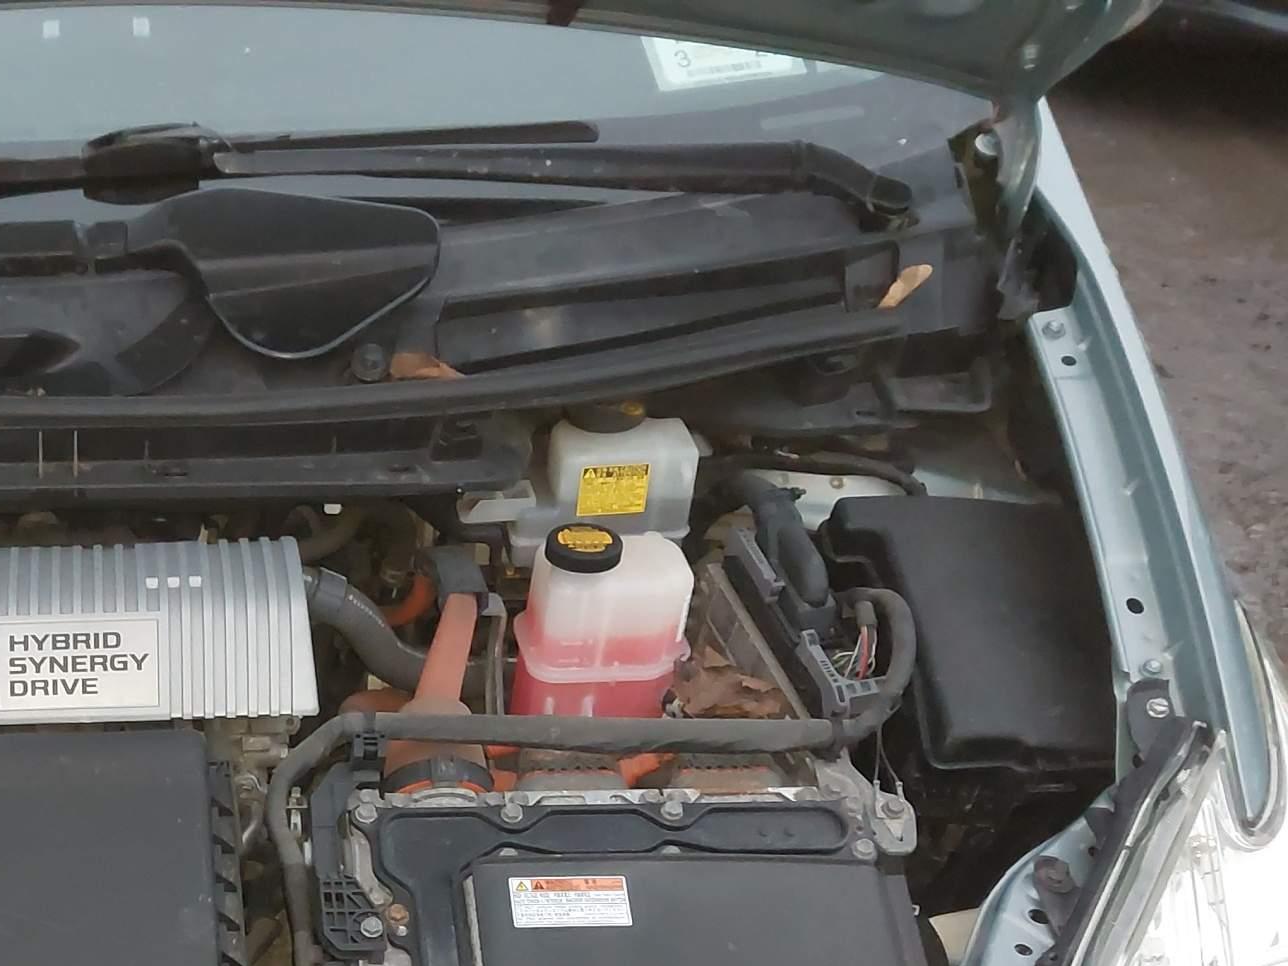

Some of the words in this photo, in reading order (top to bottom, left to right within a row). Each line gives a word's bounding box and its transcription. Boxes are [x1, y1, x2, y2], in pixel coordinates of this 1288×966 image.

[673, 49, 692, 68] 3
[8, 631, 121, 651] HYBRID
[8, 653, 149, 675] SYNERGY
[8, 677, 99, 697] DRIVE
